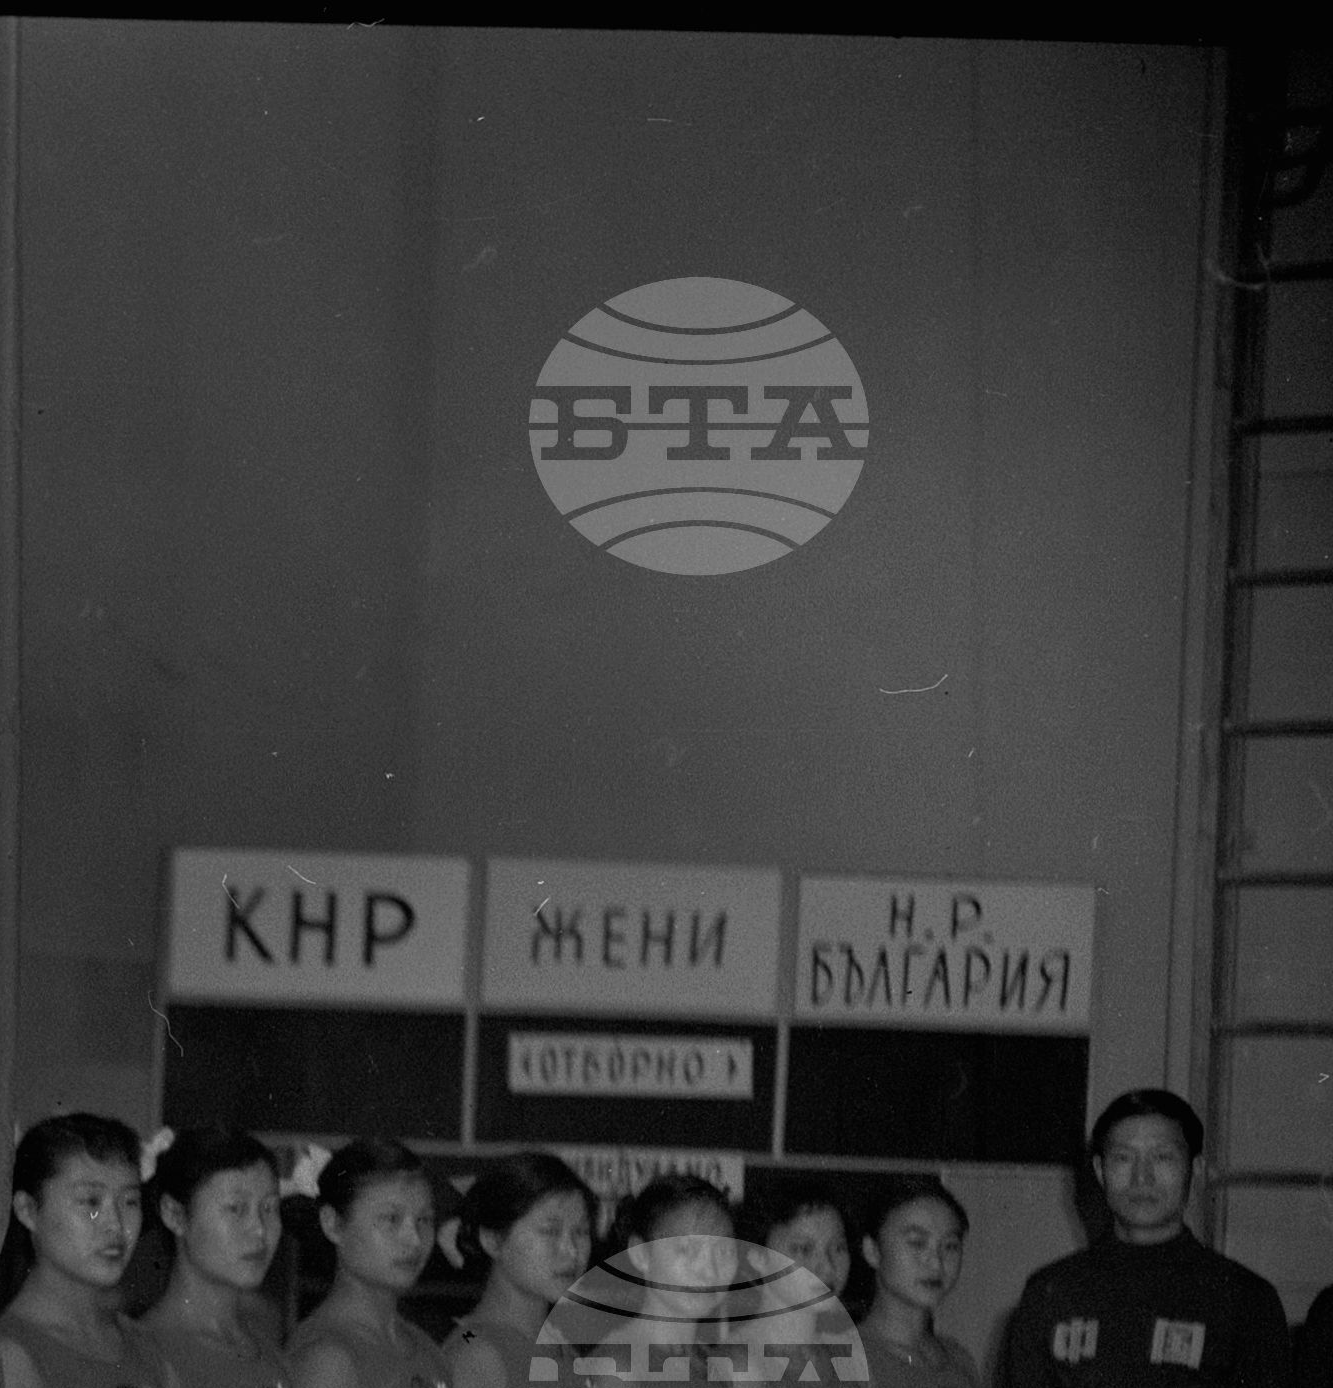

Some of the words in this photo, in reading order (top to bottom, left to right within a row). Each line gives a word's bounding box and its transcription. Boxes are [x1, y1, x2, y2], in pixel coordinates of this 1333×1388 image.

[224, 885, 416, 967] КНР
[529, 904, 729, 969] ЖЕНИ
[810, 941, 1071, 1012] БЪЛГАРИЯ
